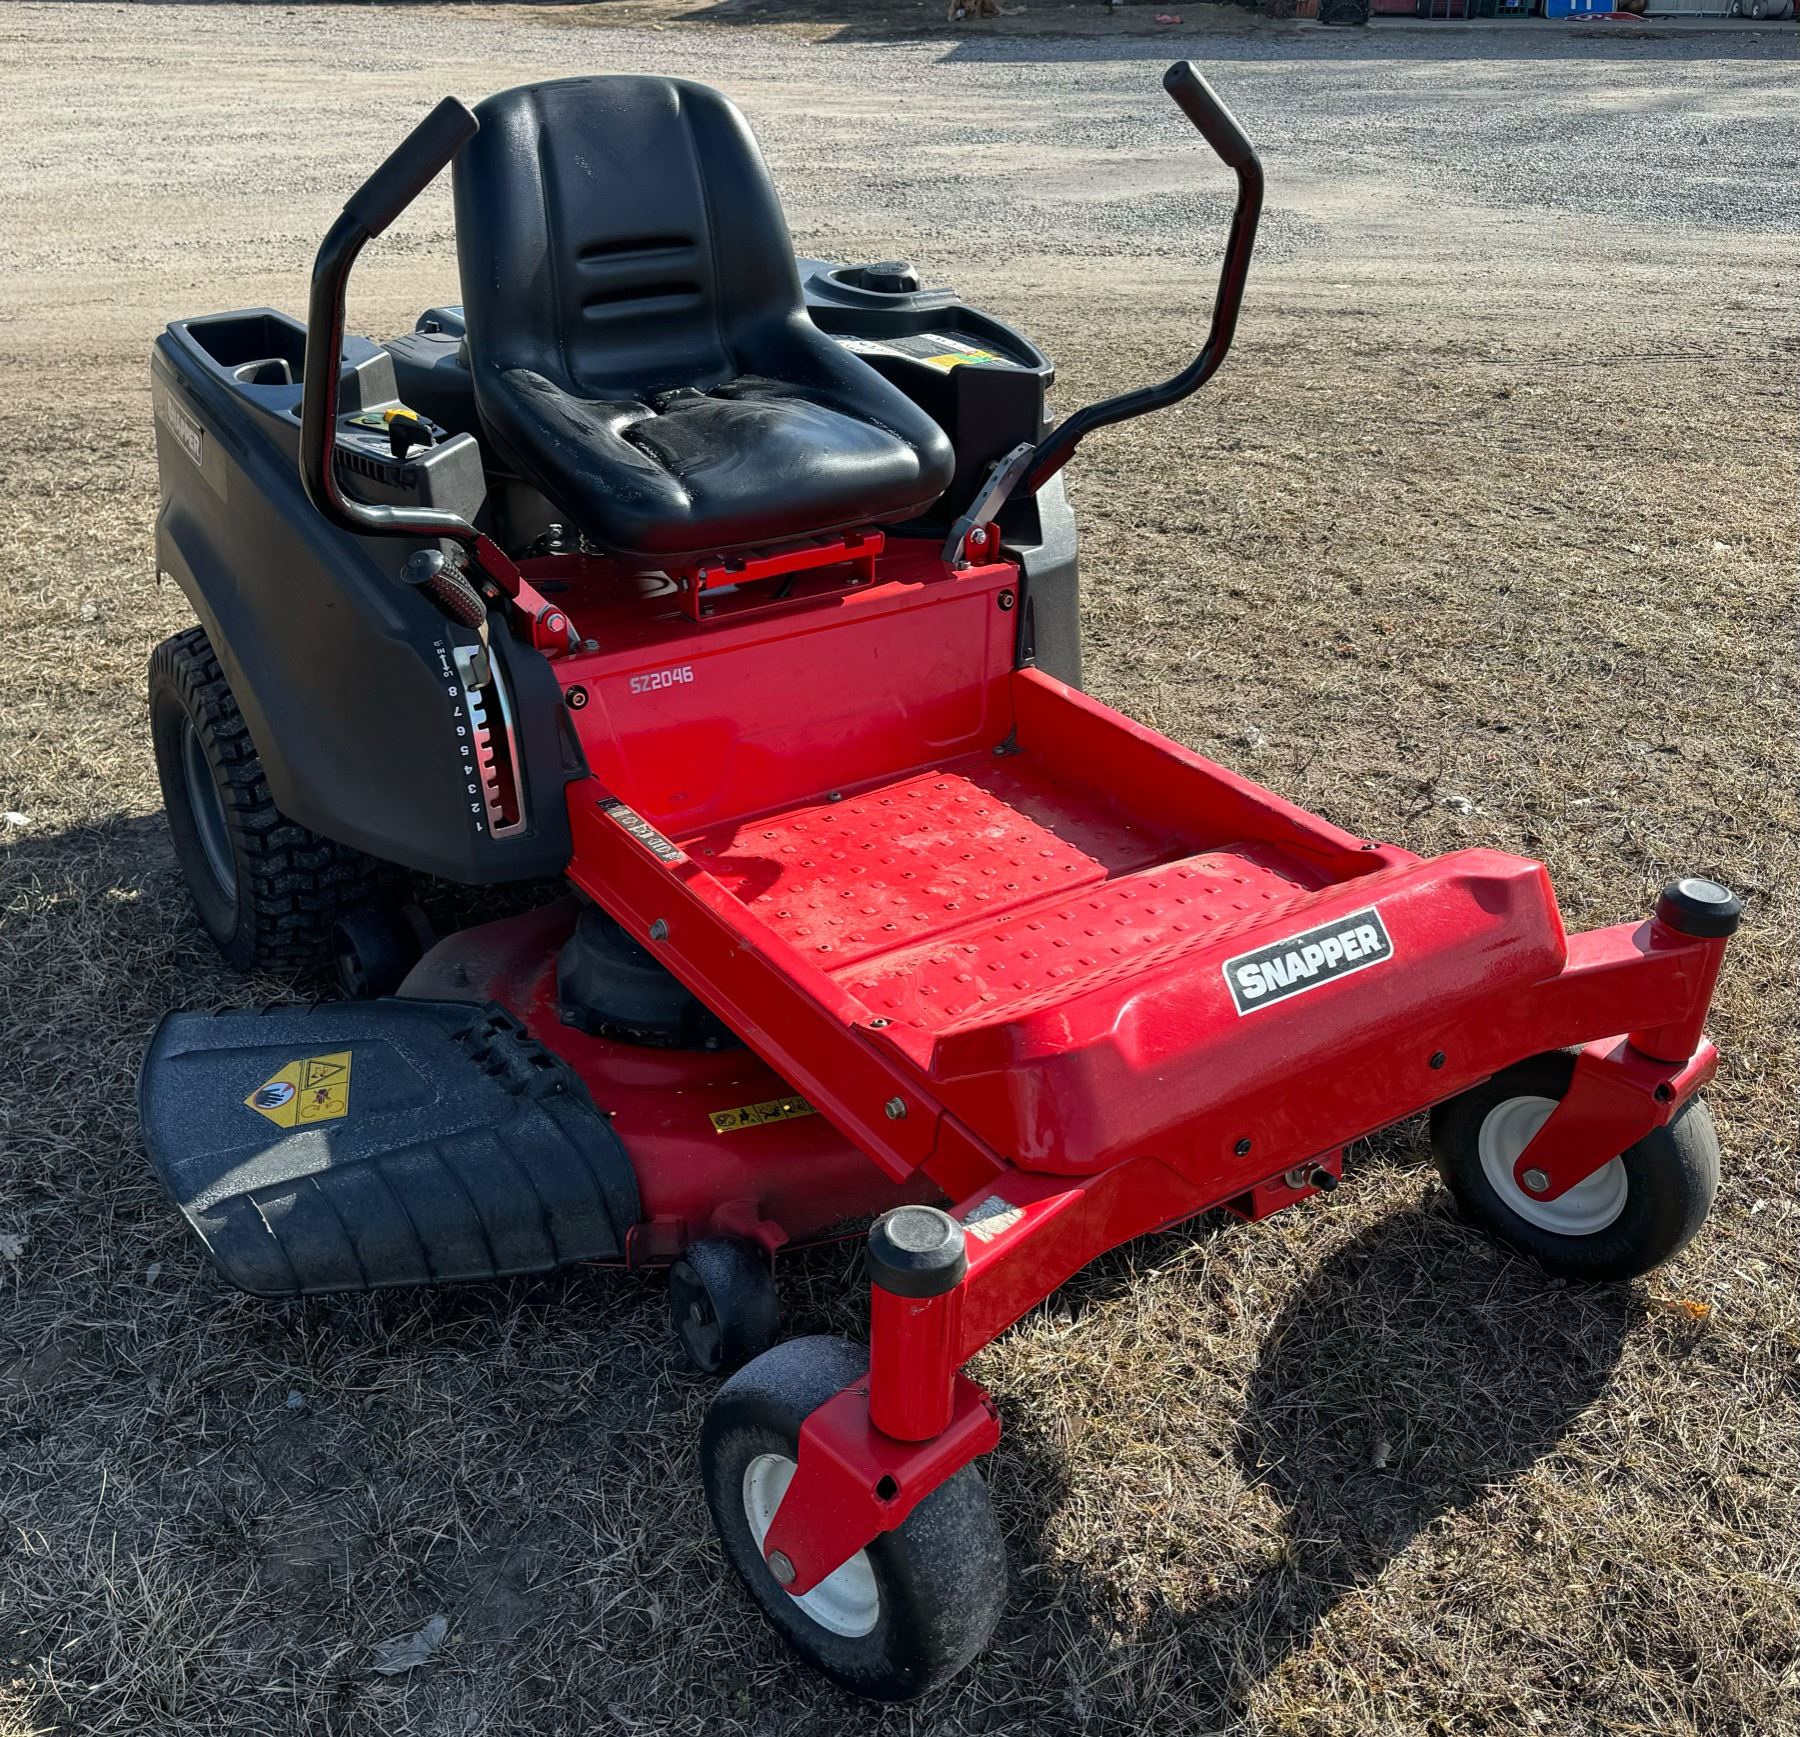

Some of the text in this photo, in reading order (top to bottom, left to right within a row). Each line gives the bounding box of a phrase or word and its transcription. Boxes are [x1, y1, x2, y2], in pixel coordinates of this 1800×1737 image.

[630, 666, 694, 694] SZ2046
[448, 686, 458, 697] 8
[453, 706, 463, 717] 7
[456, 726, 466, 736] 6
[460, 745, 470, 756] 5
[464, 765, 473, 775] 4
[467, 783, 477, 794] 3
[471, 803, 480, 813] 2
[475, 821, 483, 832] 1
[1236, 924, 1383, 999] SNAPPER
